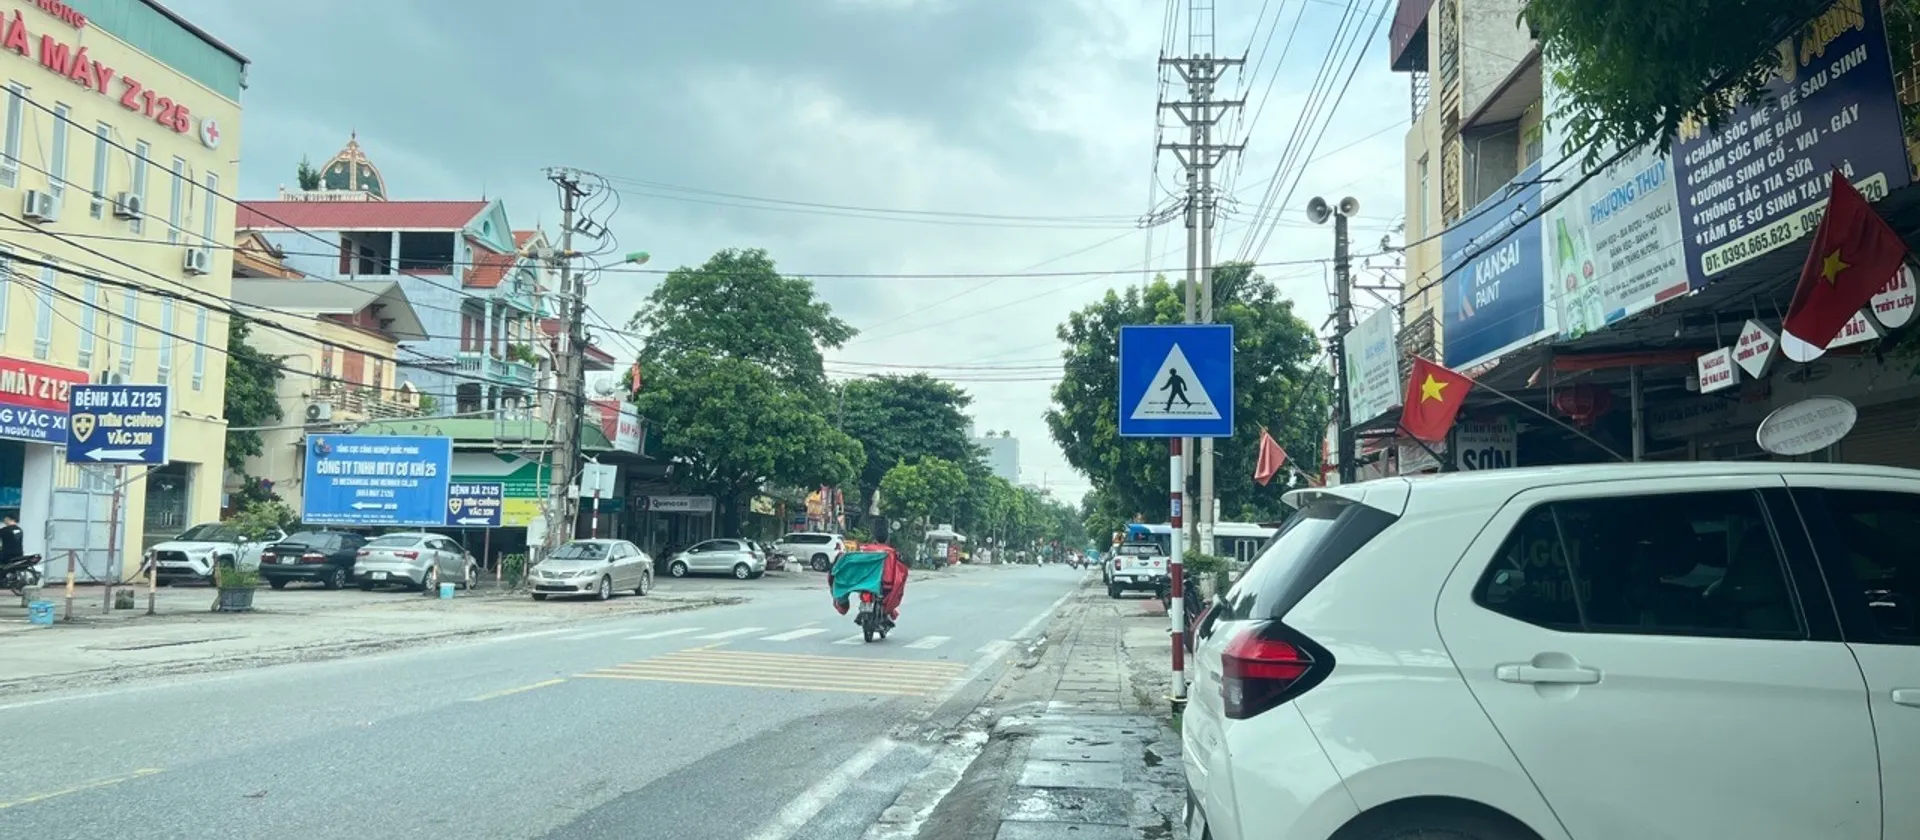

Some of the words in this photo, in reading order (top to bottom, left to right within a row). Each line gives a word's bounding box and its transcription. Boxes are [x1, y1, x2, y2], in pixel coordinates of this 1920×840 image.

[40, 34, 114, 94] MÁY
[120, 76, 190, 132] Z125
[1725, 121, 1748, 144] SÓC
[1750, 106, 1770, 130] MẸ
[1780, 87, 1798, 111] BÉ
[1801, 70, 1828, 98] SAU
[1830, 44, 1867, 79] SINH
[1728, 143, 1751, 165] SÓC
[1754, 128, 1773, 146] MẸ
[1736, 158, 1765, 184] SINH
[1768, 140, 1785, 167] CỔ
[1796, 128, 1818, 151] VAI
[1830, 104, 1858, 132] GÁY
[1700, 197, 1736, 224] THÔNG
[1762, 173, 1784, 193] TIA
[1728, 211, 1744, 233] BÉ
[1746, 203, 1764, 225] SƠ
[1766, 189, 1798, 216] SINH
[1799, 177, 1822, 199] TẠI
[1722, 222, 1792, 265] 0393.665.623
[1476, 239, 1519, 288] KANSAI
[1476, 280, 1500, 309] PAINT
[2, 368, 37, 396] MÁY
[75, 388, 109, 410] BỆNH
[111, 388, 128, 407] XÁ
[131, 392, 162, 408] Z125
[132, 432, 153, 446] XIN
[317, 458, 340, 475] CÔNG
[342, 461, 353, 475] TY
[377, 462, 396, 476] MTV
[425, 462, 437, 477] 25
[1463, 446, 1511, 470] SƠN
[482, 486, 499, 496] Z125
